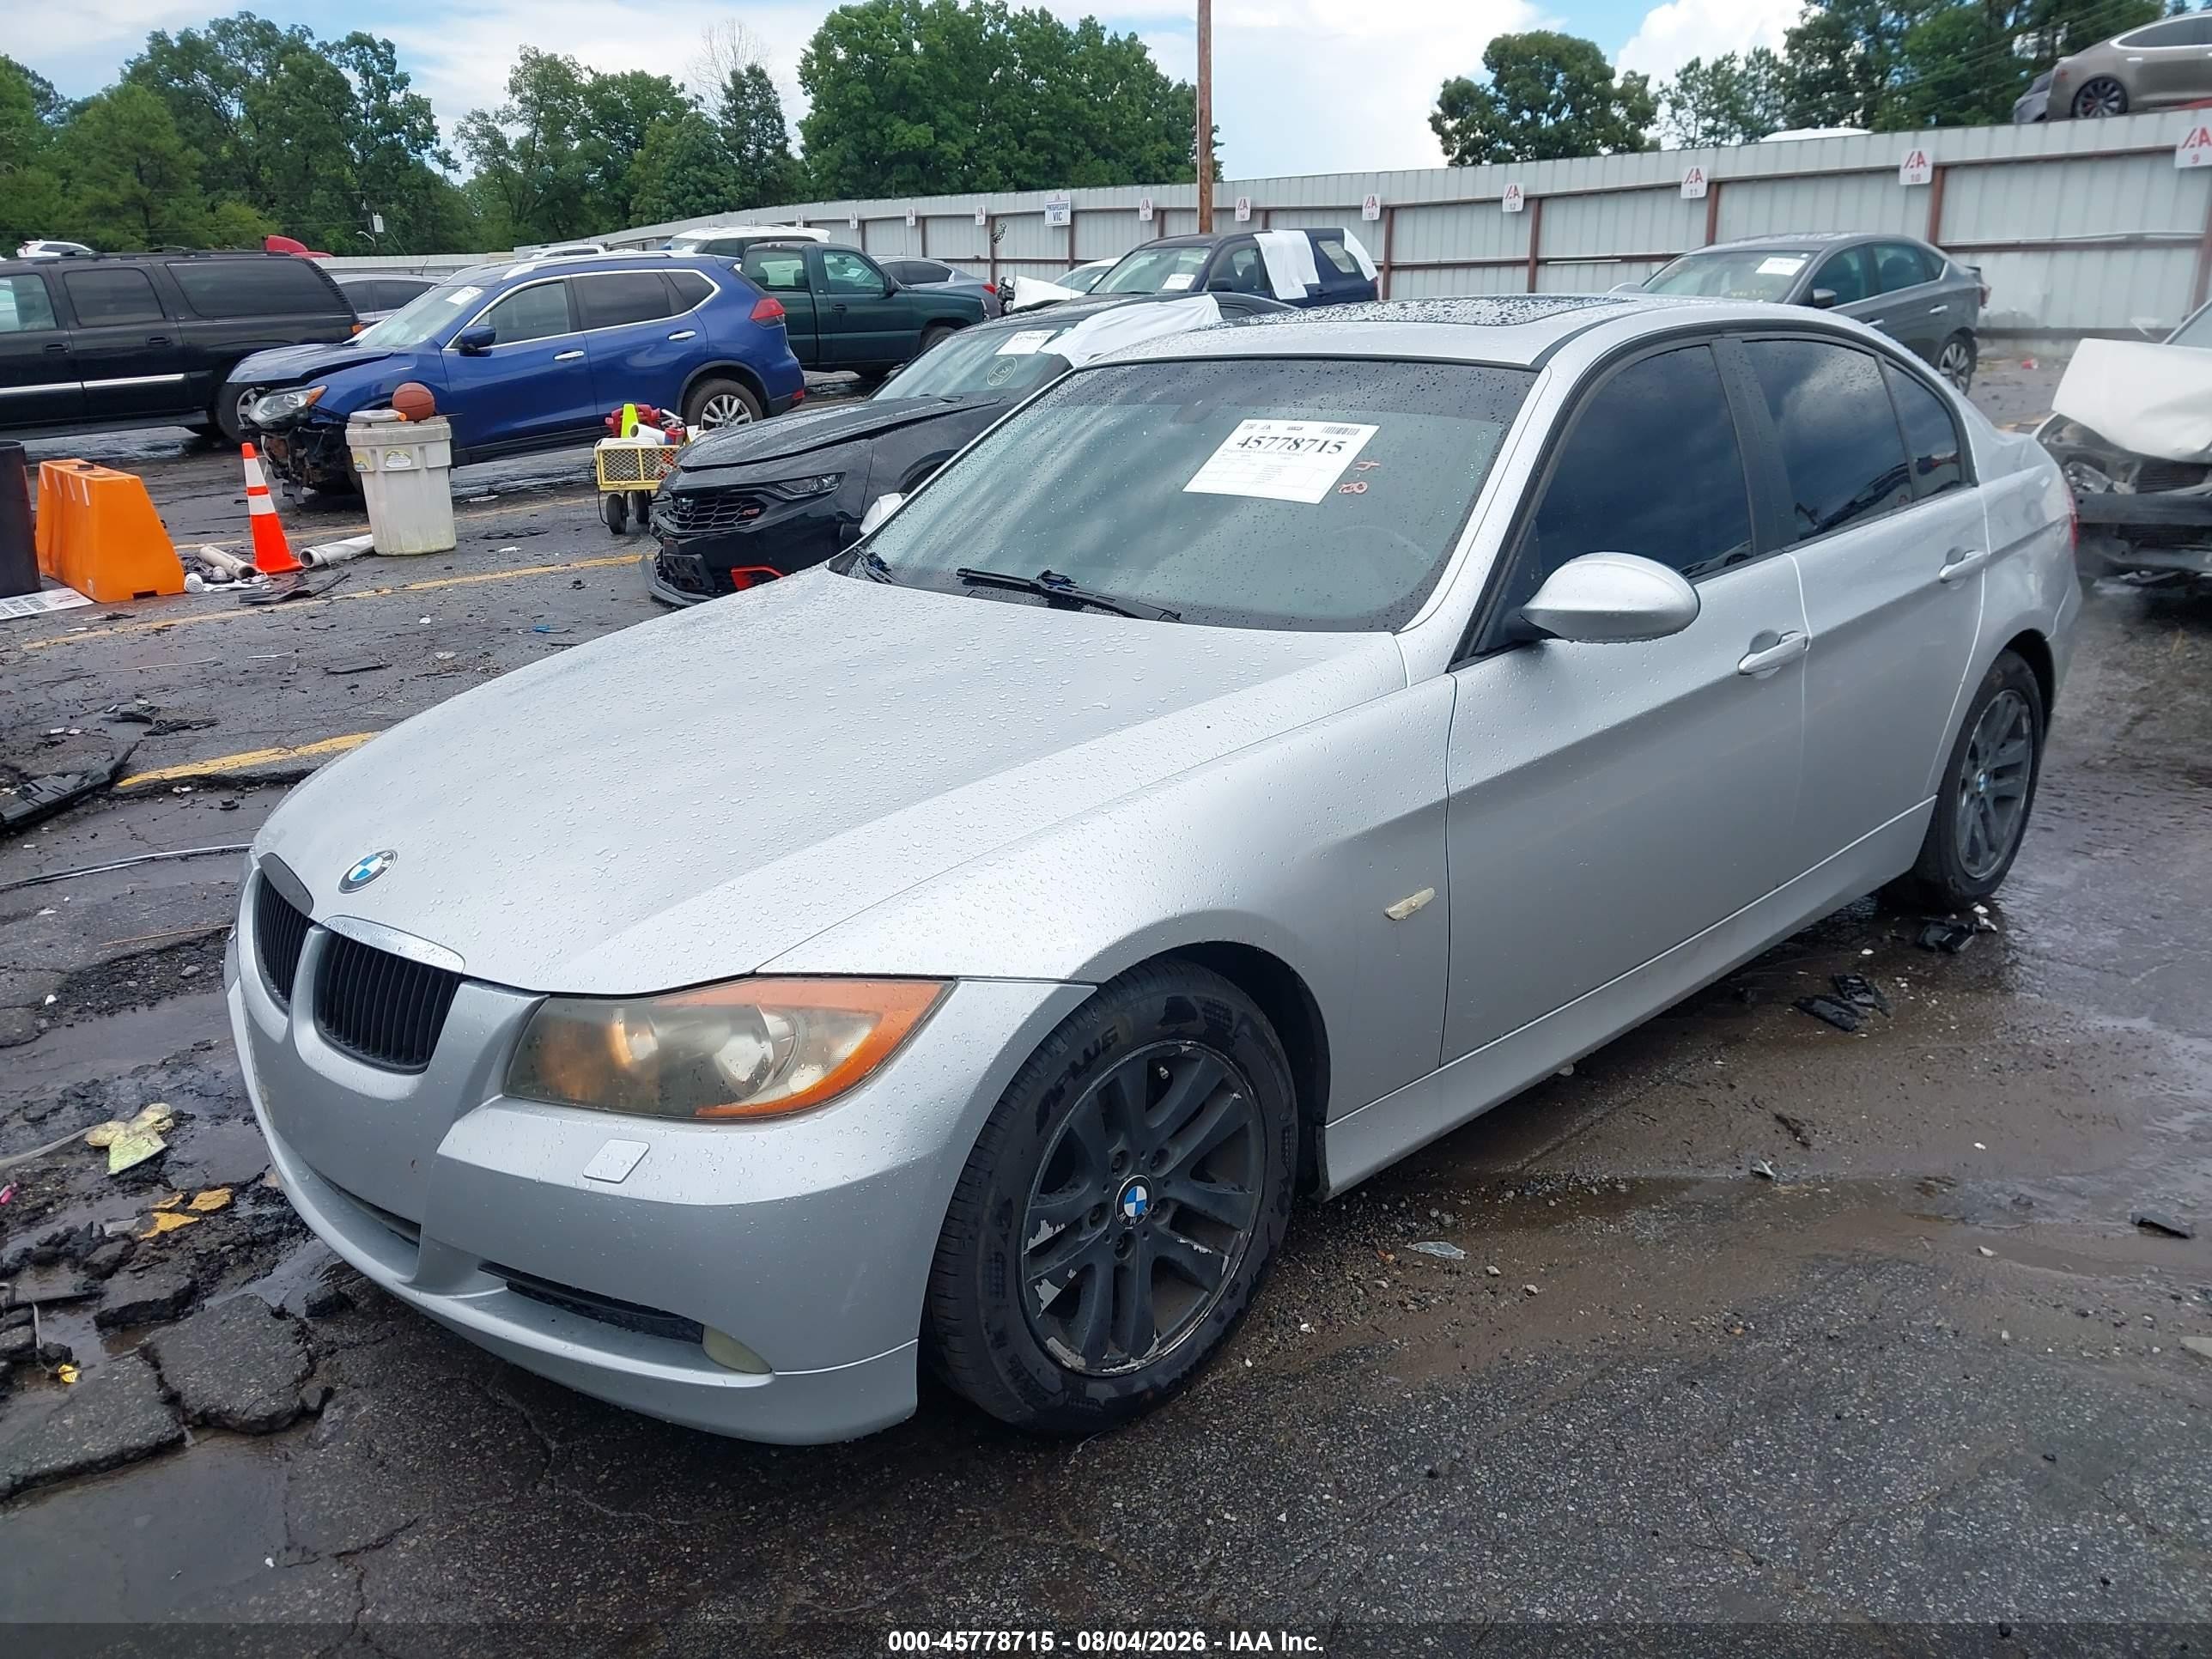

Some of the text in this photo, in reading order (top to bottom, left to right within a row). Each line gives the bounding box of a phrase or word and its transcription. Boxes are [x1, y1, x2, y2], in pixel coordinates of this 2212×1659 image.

[2191, 154, 2200, 165] 9
[1052, 211, 1063, 222] VIC
[1237, 435, 1347, 454] 45778715
